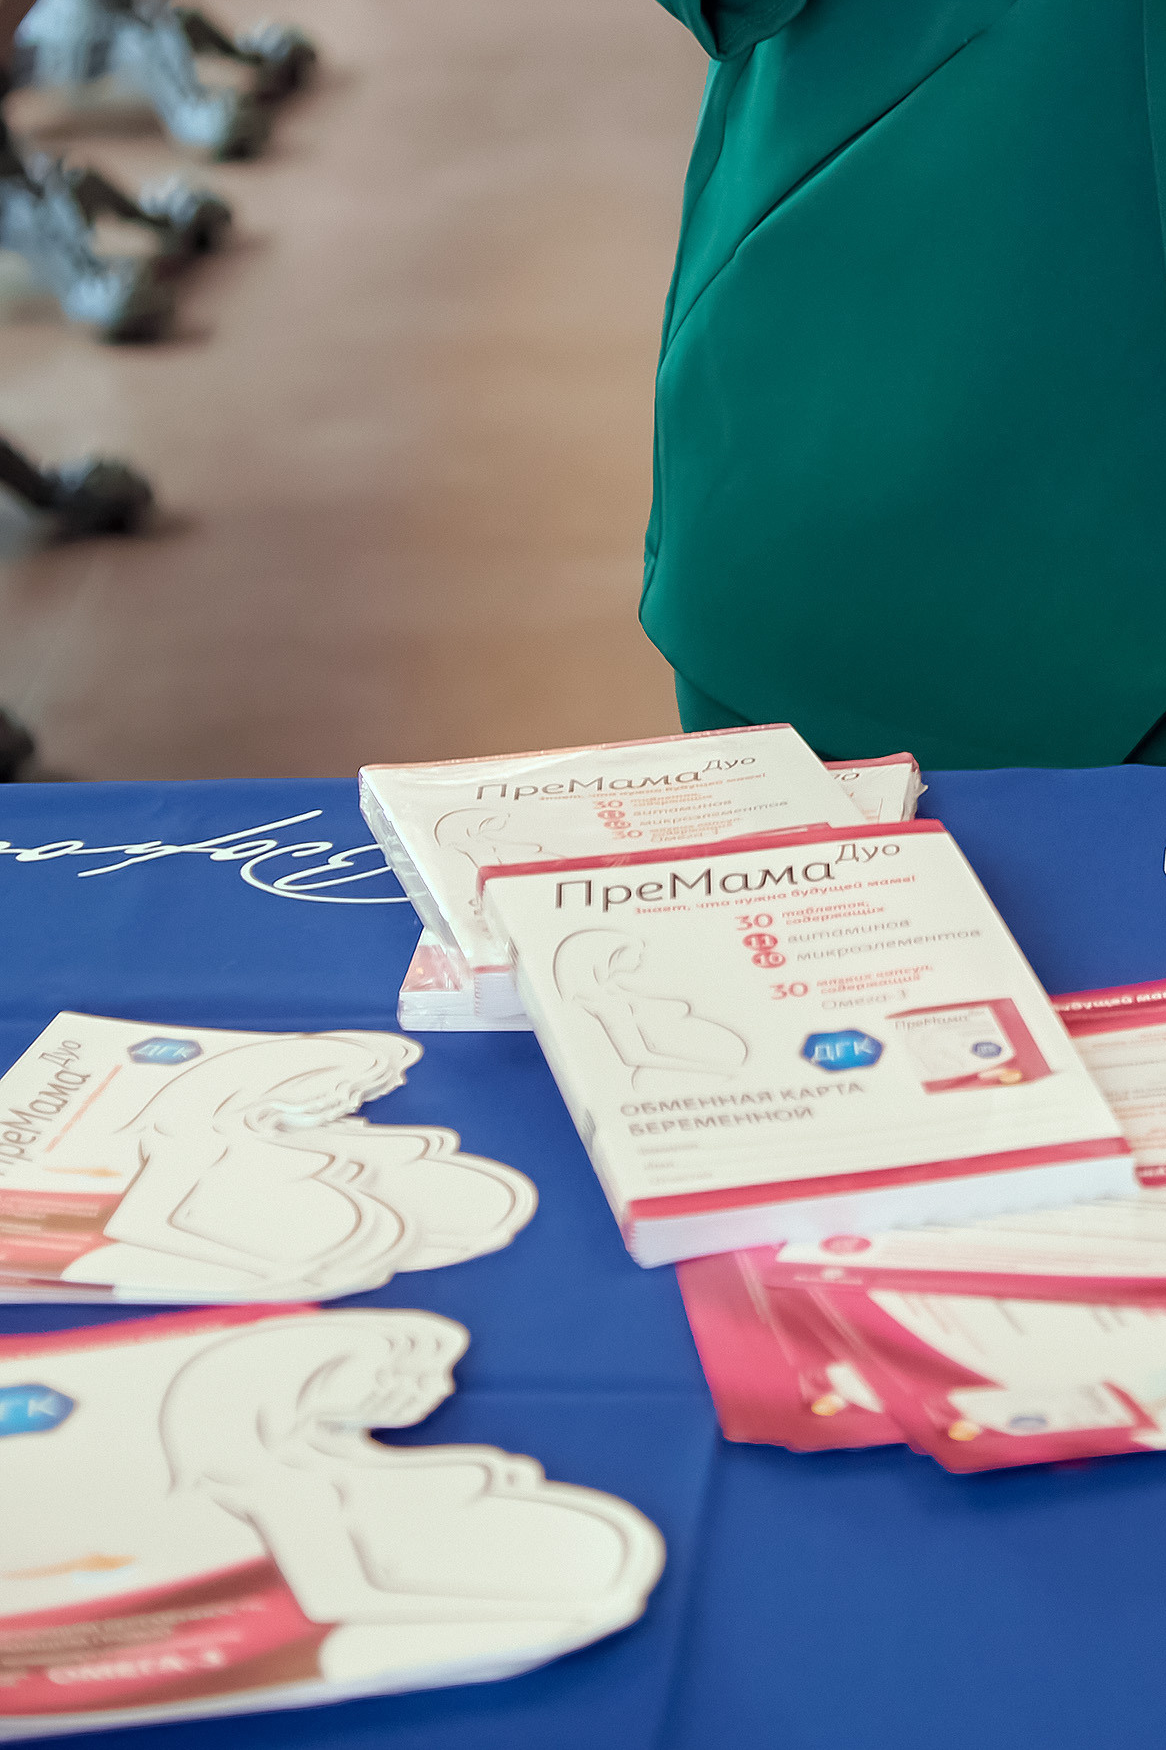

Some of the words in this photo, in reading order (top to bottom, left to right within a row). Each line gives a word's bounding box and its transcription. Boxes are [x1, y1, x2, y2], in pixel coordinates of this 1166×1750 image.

[476, 769, 703, 801] ПреМама
[702, 756, 757, 773] Дуо
[554, 861, 836, 913] ПреМама
[834, 842, 901, 866] Дуо
[735, 912, 774, 932] 30
[787, 919, 911, 944] витаминов
[796, 929, 982, 963] микроэлементов
[769, 981, 809, 1001] 30
[38, 1039, 82, 1068] Дуо
[811, 1038, 874, 1065] ДГК
[619, 1088, 775, 1118] ОБМЕННАЯ
[780, 1080, 866, 1103] КАРТА
[628, 1106, 817, 1138] БЕРЕМЕННОЙ
